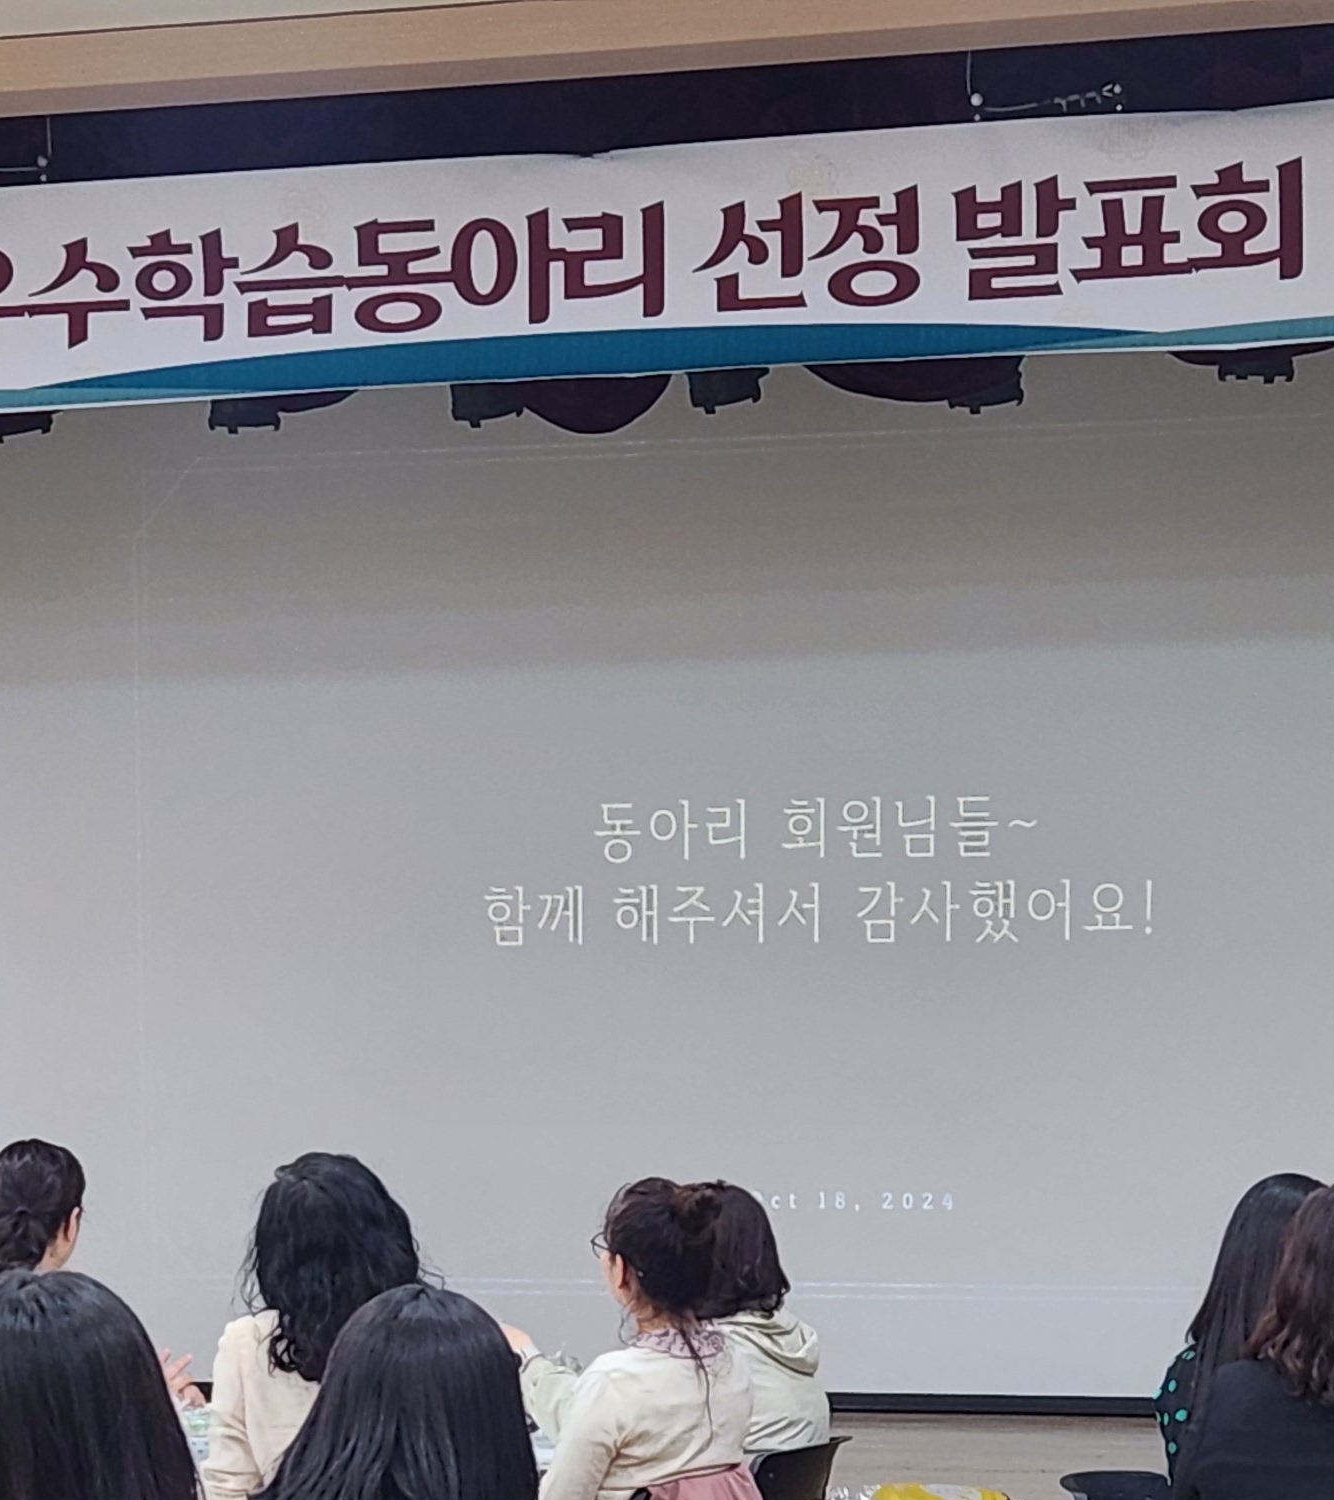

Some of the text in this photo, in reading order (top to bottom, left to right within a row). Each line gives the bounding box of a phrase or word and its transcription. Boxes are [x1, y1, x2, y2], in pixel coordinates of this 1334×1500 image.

[692, 183, 920, 312] 선정
[951, 155, 1303, 301] 발표회
[592, 794, 1039, 864] 동아리 회원님들~
[482, 878, 1154, 947] 함께 해주셔서 감사했어요!
[881, 1191, 954, 1211] 2024
